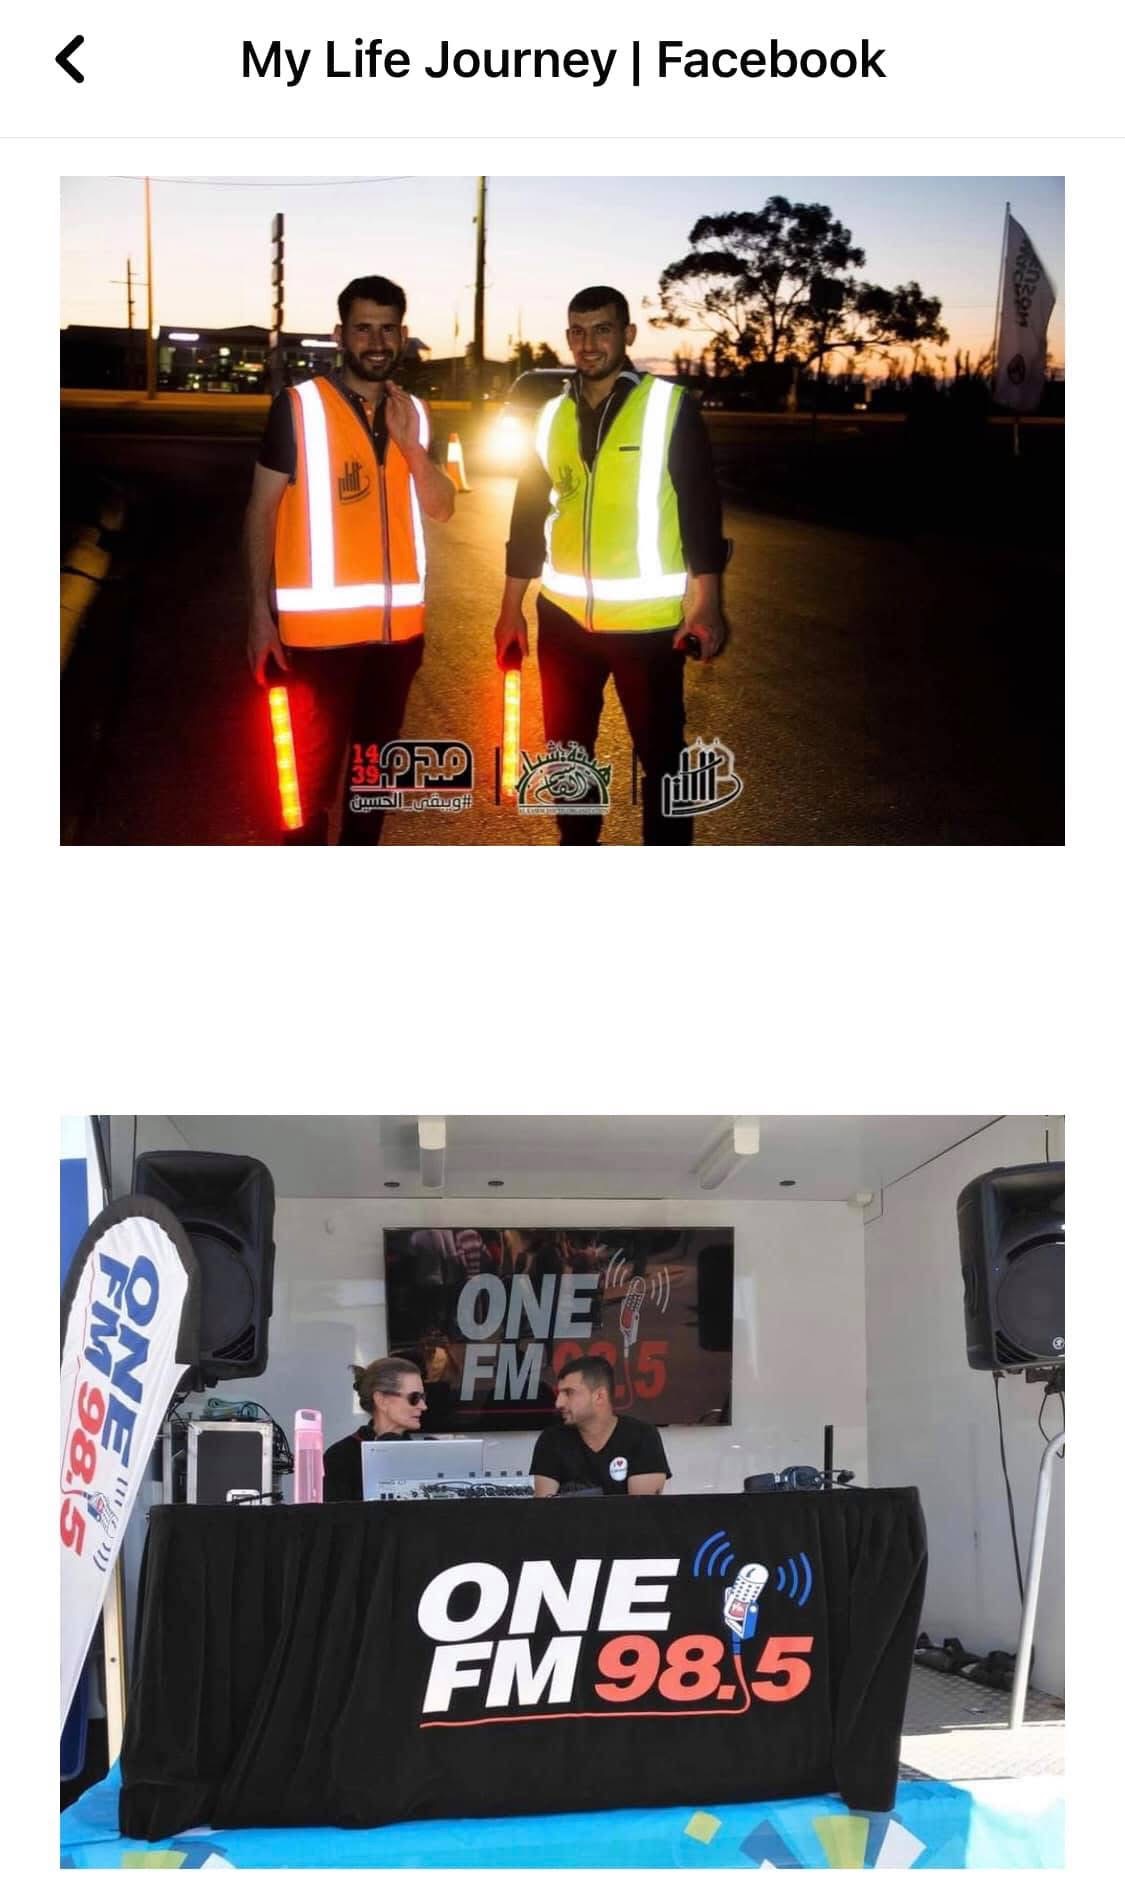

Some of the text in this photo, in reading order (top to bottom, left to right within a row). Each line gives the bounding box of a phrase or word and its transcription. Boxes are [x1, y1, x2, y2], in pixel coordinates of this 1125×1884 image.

[456, 1273, 600, 1340] ONE
[107, 1255, 160, 1468] ONE
[459, 1343, 544, 1401] FM
[60, 1252, 130, 1556] FM 98.5
[417, 1558, 681, 1642] ONE
[422, 1634, 815, 1714] FM 98.5
